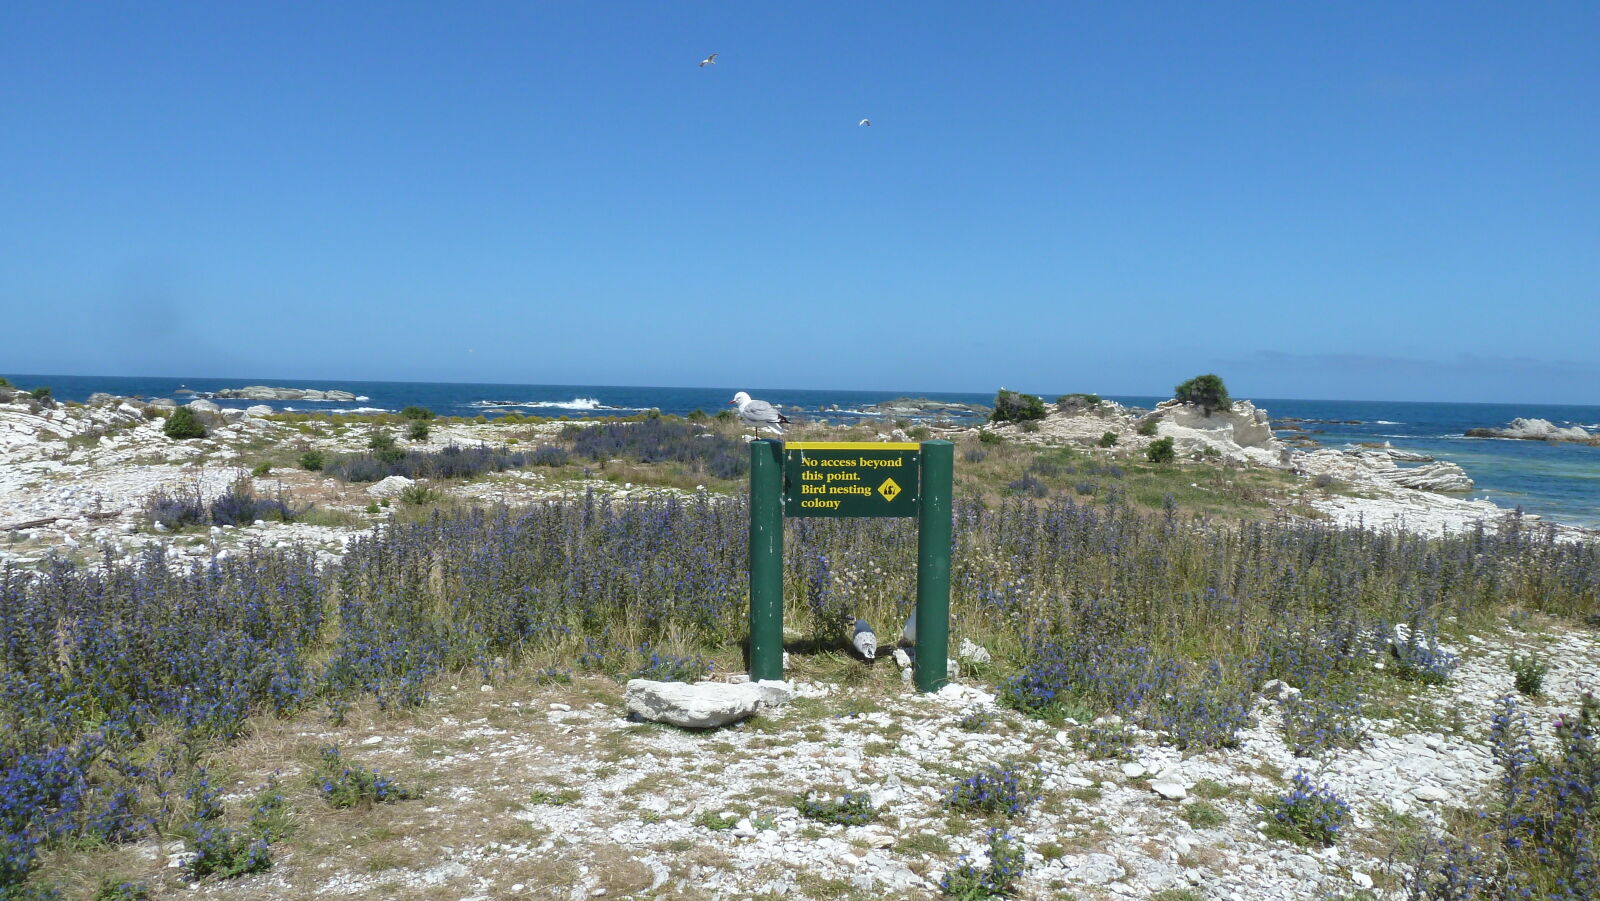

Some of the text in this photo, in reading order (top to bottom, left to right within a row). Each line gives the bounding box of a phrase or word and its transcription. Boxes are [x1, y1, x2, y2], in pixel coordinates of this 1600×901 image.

[801, 457, 902, 469] No access beyond
[801, 470, 861, 482] this point.
[801, 484, 872, 496] Bird nesting
[801, 498, 841, 510] colony
